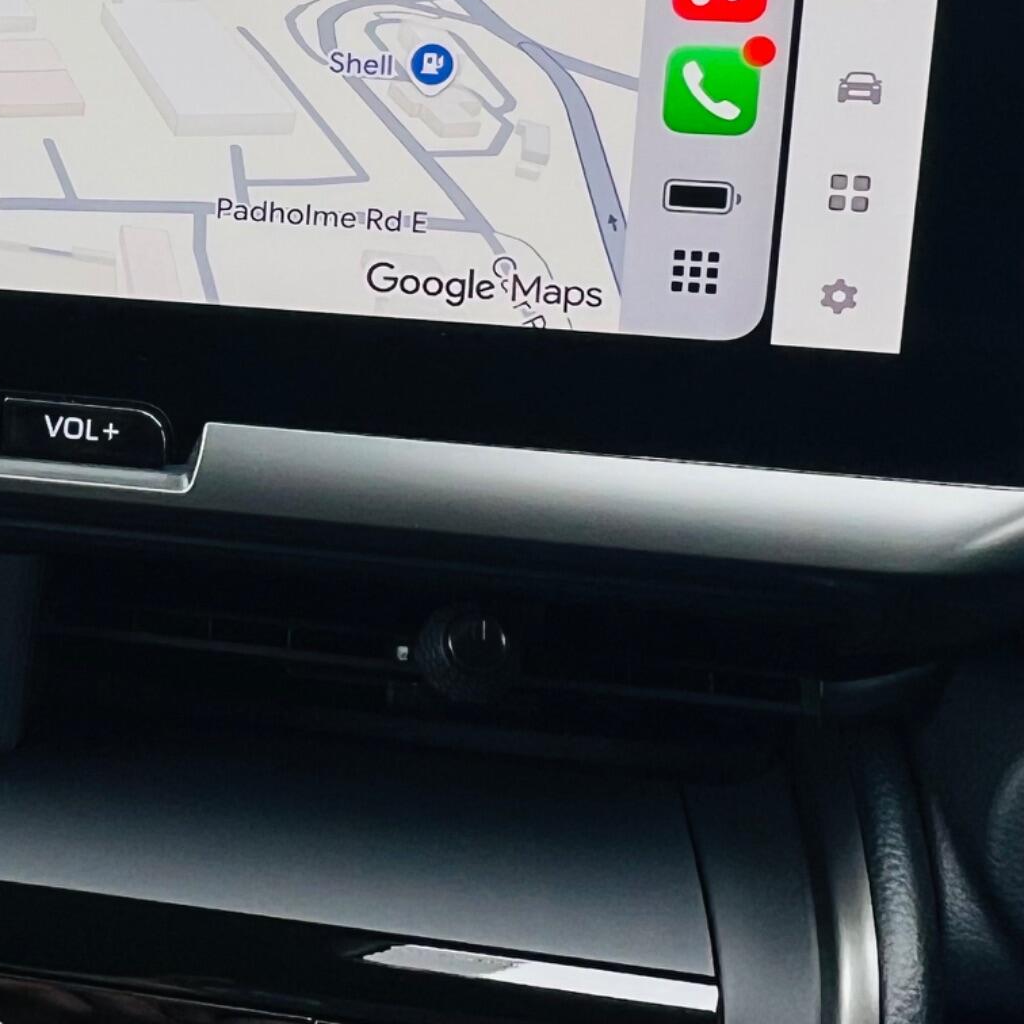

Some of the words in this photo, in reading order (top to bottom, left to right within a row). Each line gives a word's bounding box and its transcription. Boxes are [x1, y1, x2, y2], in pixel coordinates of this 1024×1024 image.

[329, 51, 392, 75] Shell
[217, 197, 356, 229] Padholme
[367, 208, 402, 232] Rd
[412, 211, 428, 234] E
[366, 262, 495, 307] Google
[511, 273, 603, 314] Maps
